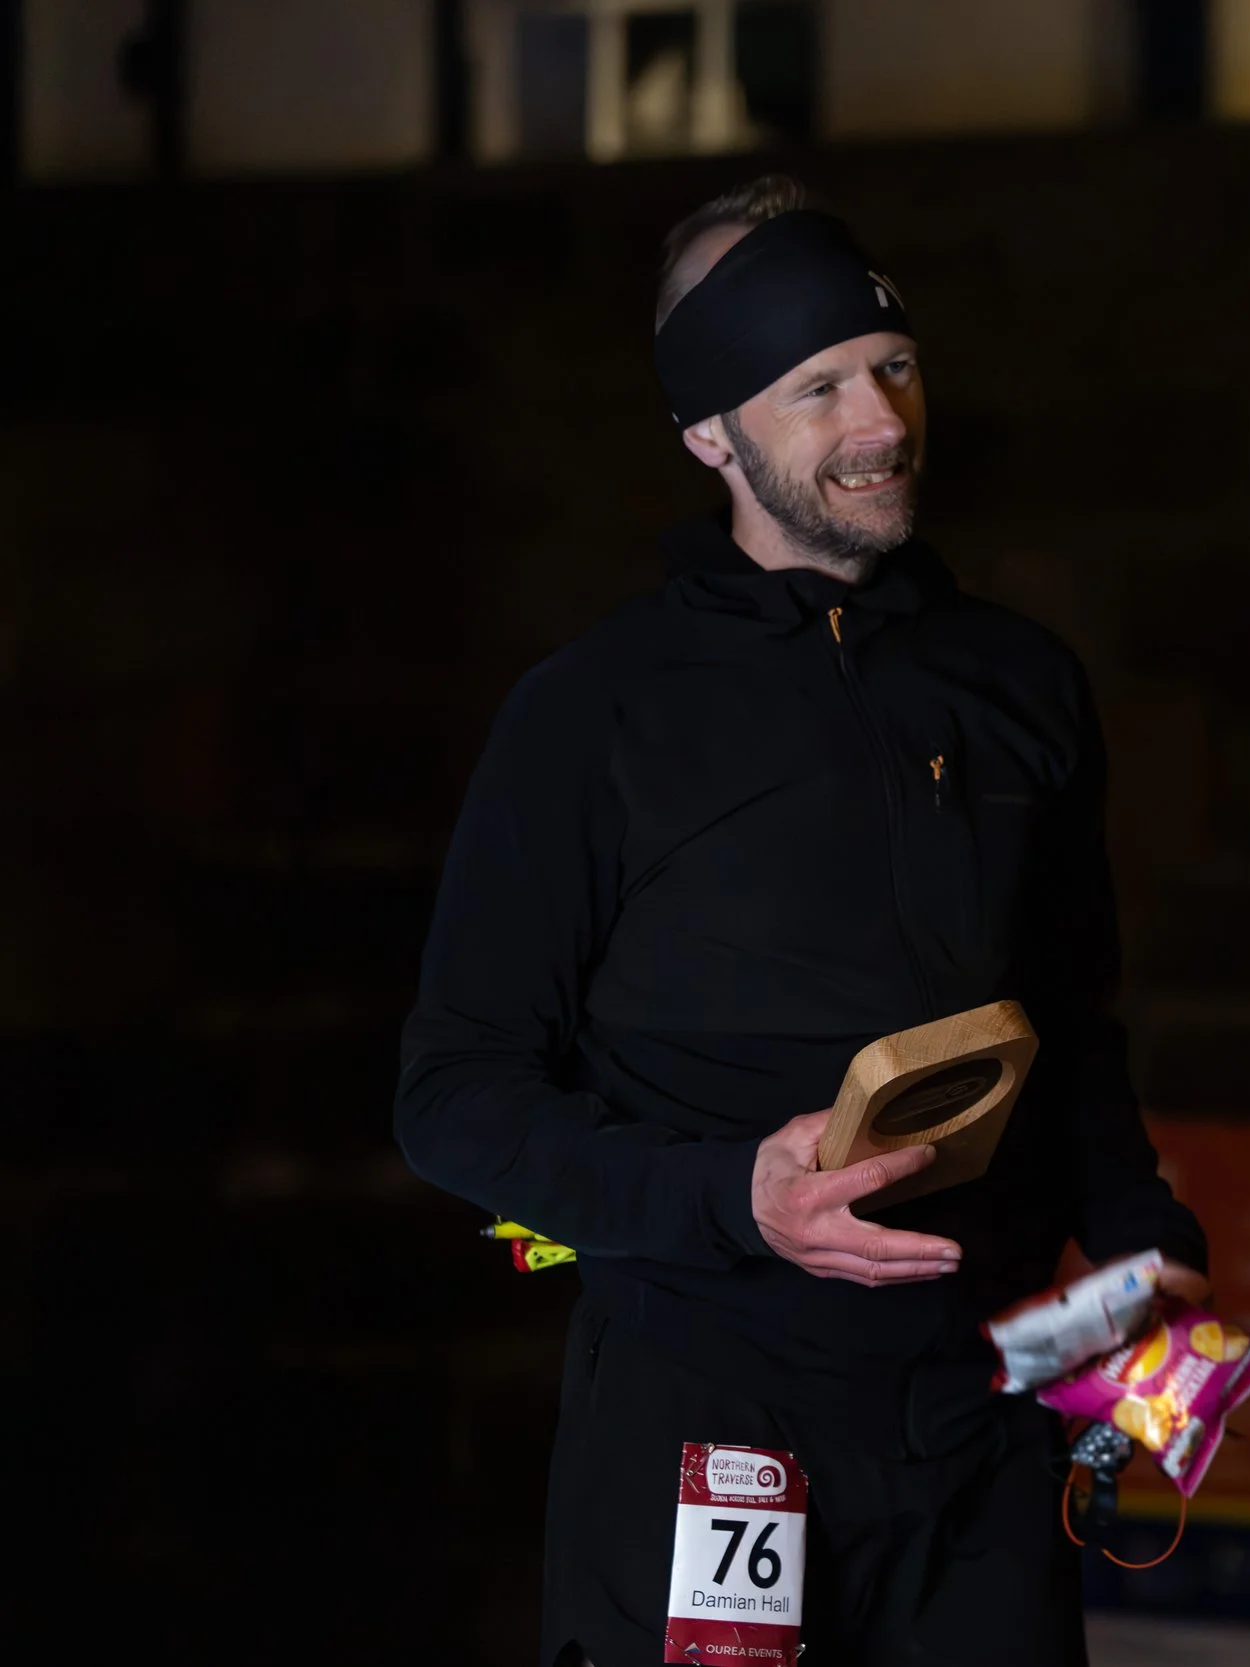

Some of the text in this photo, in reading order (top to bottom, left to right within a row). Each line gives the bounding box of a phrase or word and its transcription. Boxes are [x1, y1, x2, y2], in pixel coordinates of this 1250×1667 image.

[712, 1458, 755, 1473] NORTHERN
[712, 1473, 754, 1486] TRAVERSE
[711, 1518, 781, 1589] 76
[692, 1590, 790, 1613] Damian Hall
[706, 1644, 783, 1660] OUREA EVENTS
